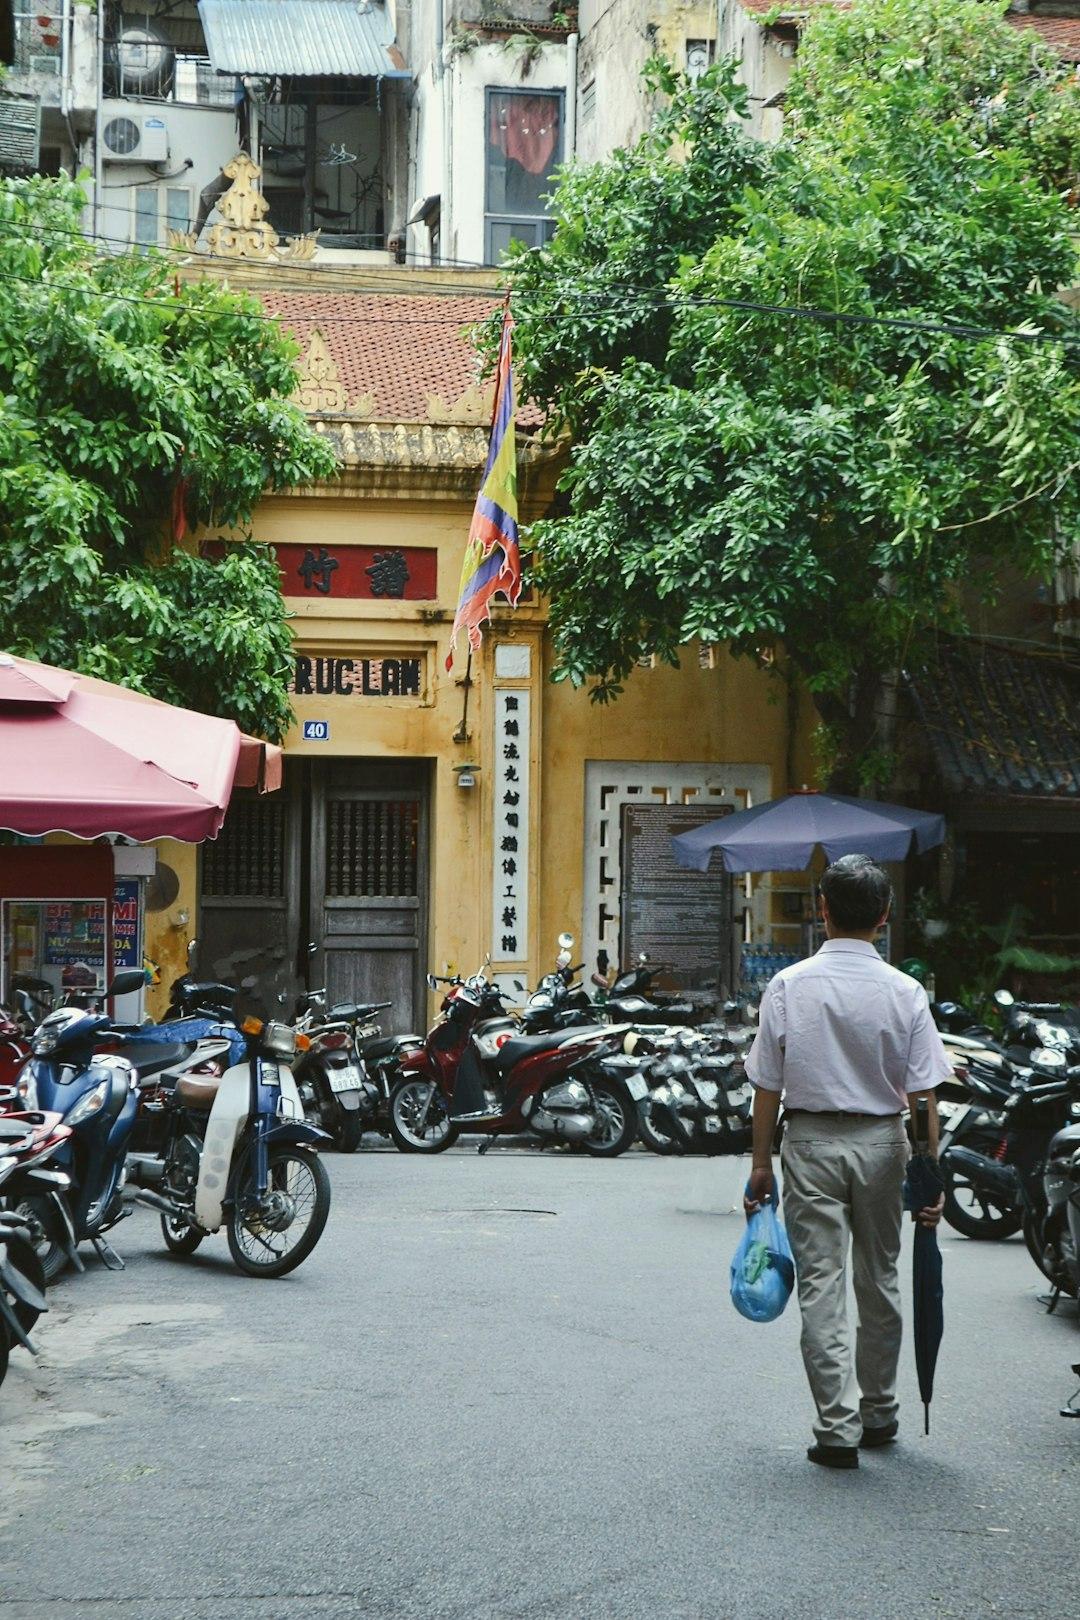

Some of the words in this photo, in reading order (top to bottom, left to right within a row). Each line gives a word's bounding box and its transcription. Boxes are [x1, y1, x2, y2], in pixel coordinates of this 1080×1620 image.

[295, 656, 354, 695] RUC
[362, 658, 419, 696] LAM
[307, 723, 325, 738] 40
